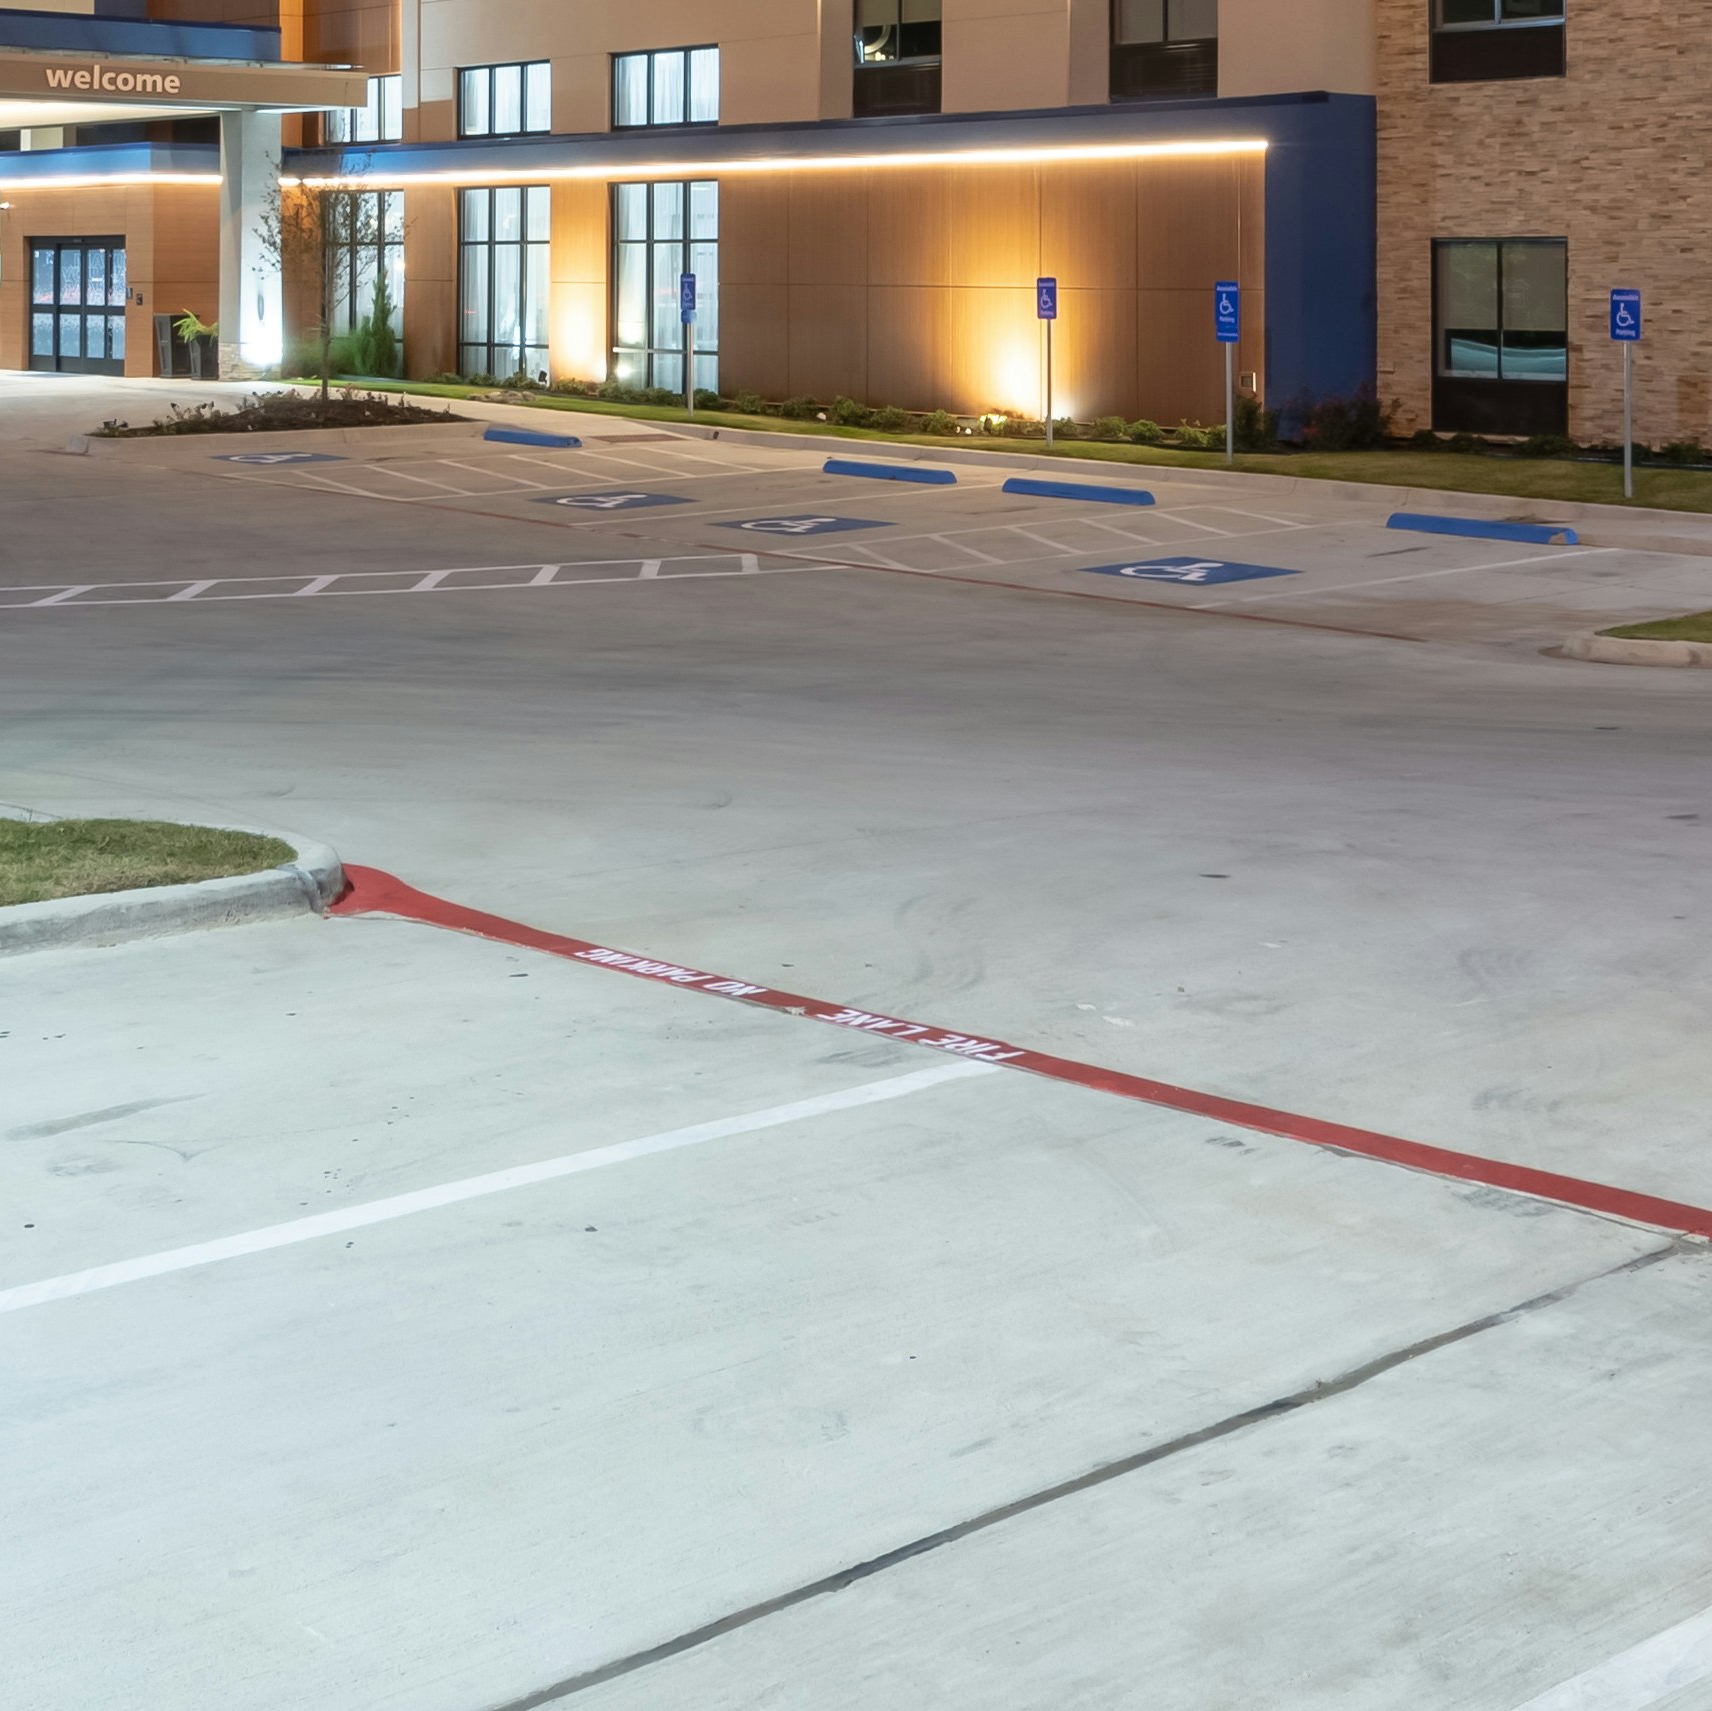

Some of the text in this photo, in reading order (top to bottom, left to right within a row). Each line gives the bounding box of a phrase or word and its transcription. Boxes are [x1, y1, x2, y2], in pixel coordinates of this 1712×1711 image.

[45, 64, 181, 94] welcome
[573, 948, 1027, 1062] FIRE LANE NO PARKING
